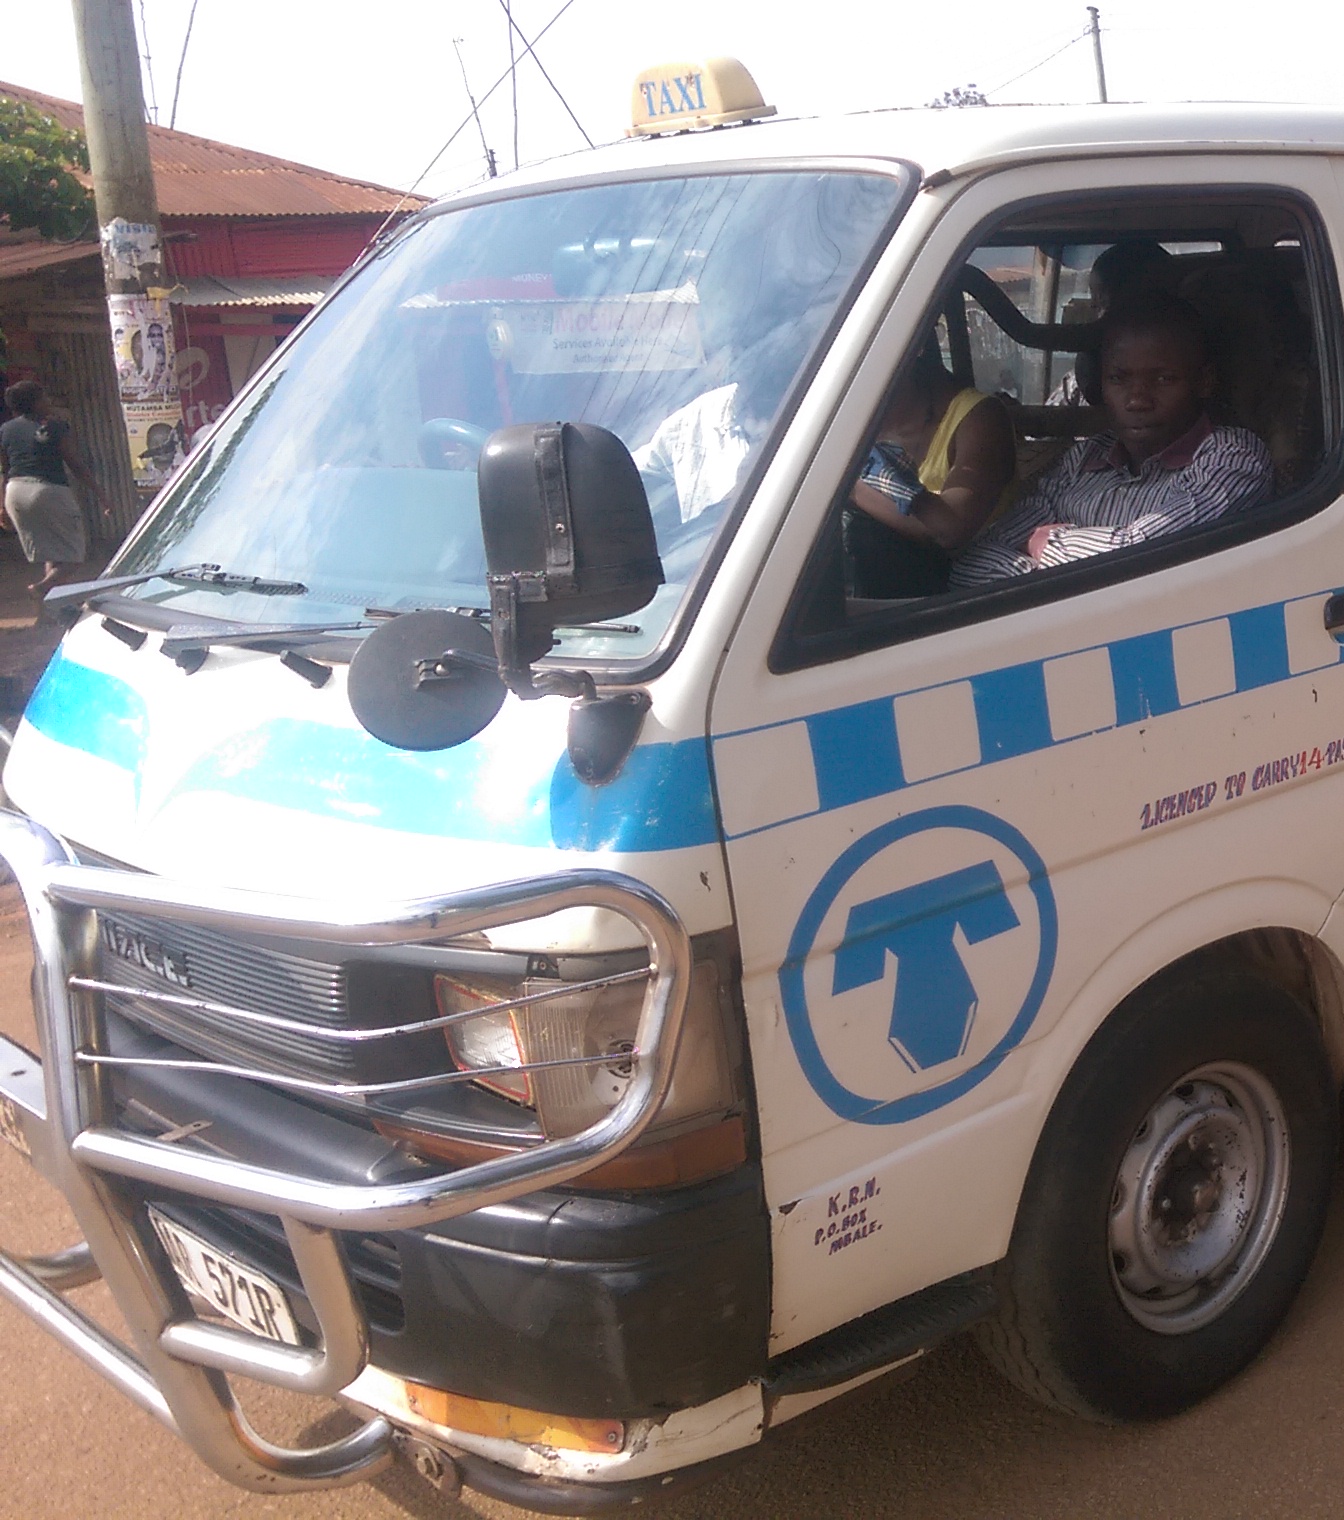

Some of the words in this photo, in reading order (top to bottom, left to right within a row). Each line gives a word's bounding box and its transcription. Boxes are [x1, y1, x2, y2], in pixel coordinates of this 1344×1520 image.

[639, 73, 707, 117] TAXI
[1140, 781, 1218, 830] LICENCED
[1224, 771, 1246, 800] TO
[1252, 753, 1300, 791] CARRY
[200, 1251, 285, 1342] 571R
